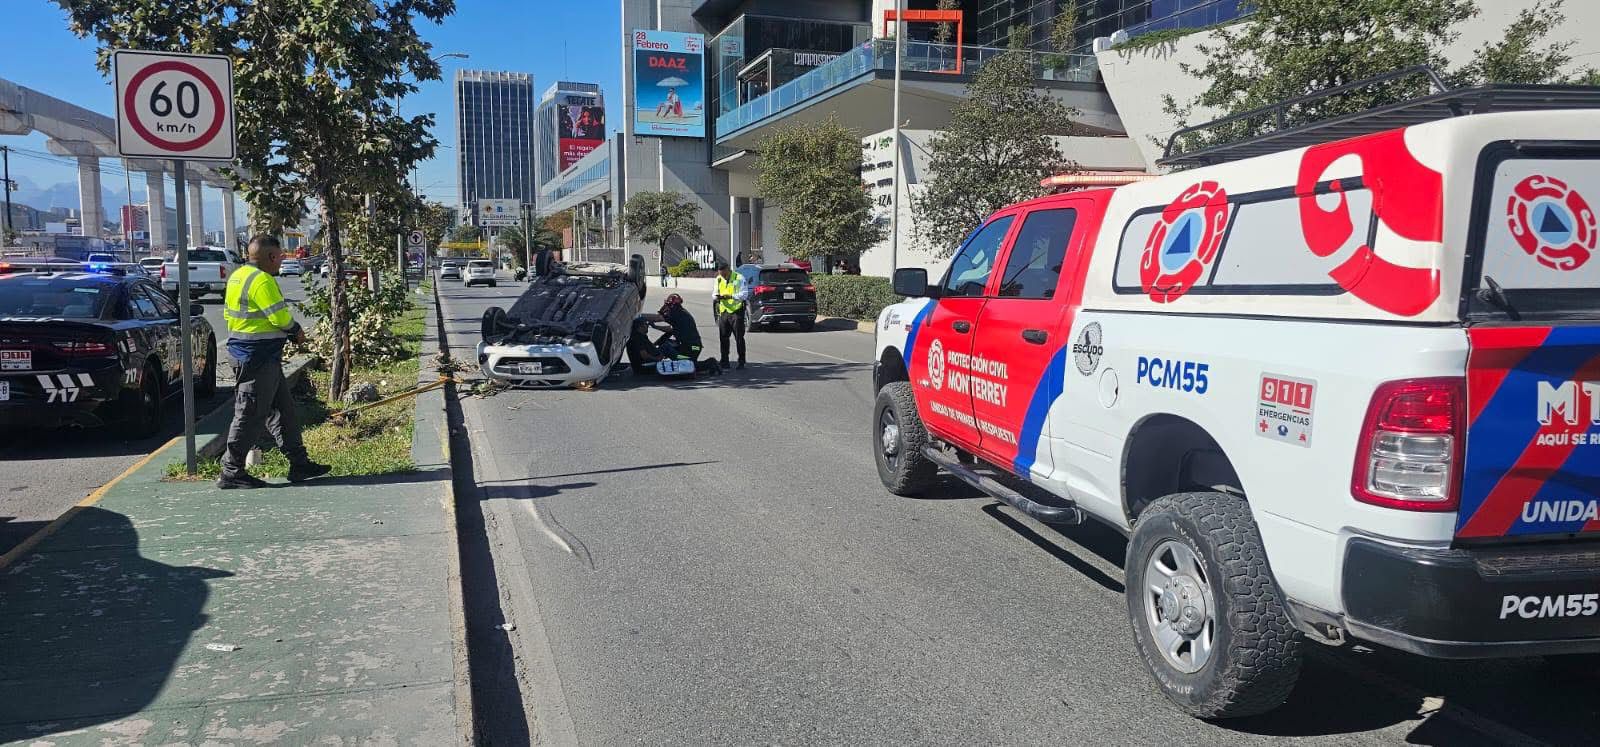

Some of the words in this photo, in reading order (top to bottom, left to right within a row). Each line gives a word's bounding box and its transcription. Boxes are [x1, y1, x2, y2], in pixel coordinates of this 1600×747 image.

[636, 32, 646, 40] 28
[636, 40, 669, 50] Febrero
[648, 56, 686, 69] DAAZ
[149, 80, 200, 119] 60
[156, 122, 196, 134] km/h
[3, 352, 29, 360] 911
[1073, 343, 1104, 356] ESCUDO
[948, 350, 989, 374] PROTECCIÓN
[989, 360, 1008, 380] CIVIL
[1136, 356, 1209, 395] PCM55
[45, 387, 80, 403] 717
[948, 370, 1007, 408] MONTERREY
[1264, 381, 1308, 405] 911
[1259, 408, 1310, 426] EMERGENCIAS
[1536, 428, 1569, 447] AQUÍ
[1571, 433, 1587, 445] SE
[1499, 593, 1599, 620] PCM55
